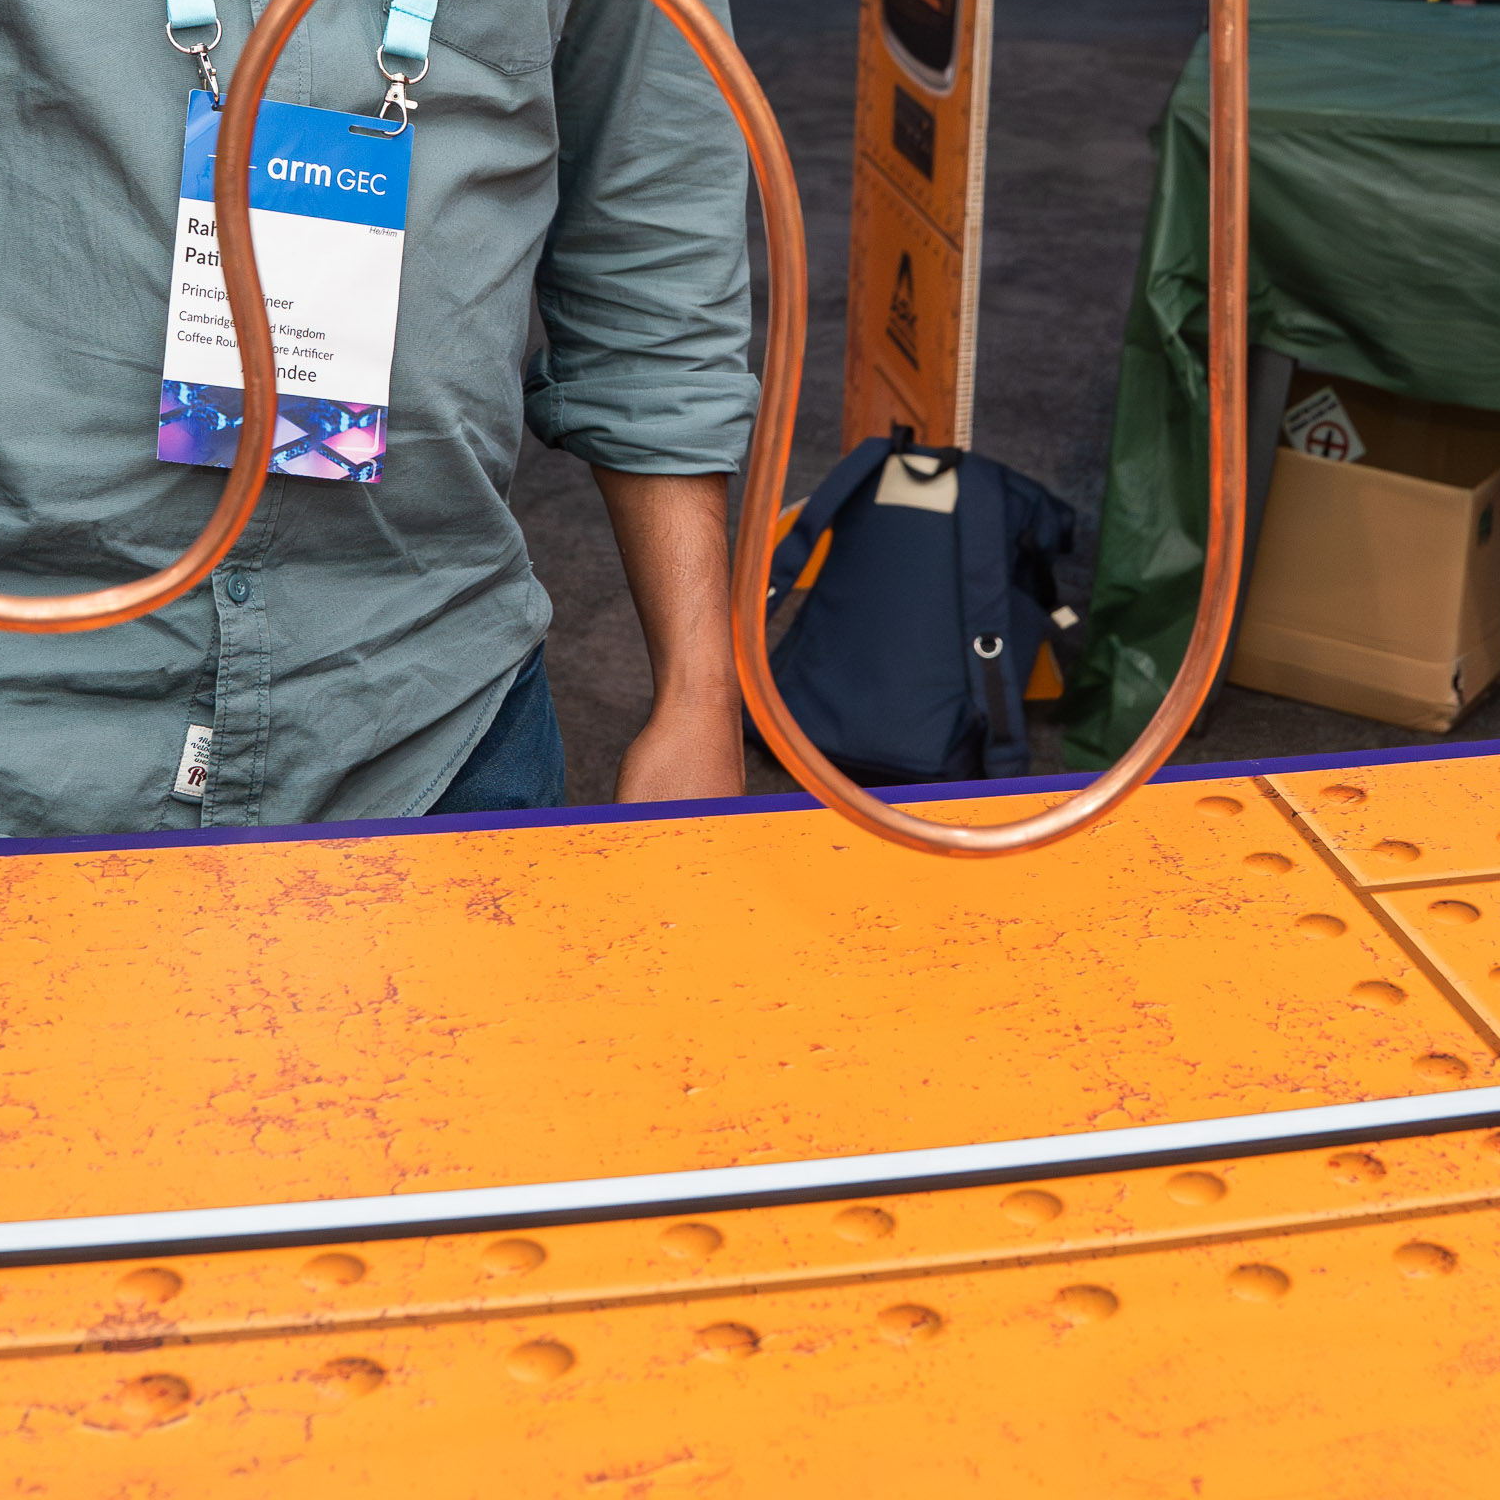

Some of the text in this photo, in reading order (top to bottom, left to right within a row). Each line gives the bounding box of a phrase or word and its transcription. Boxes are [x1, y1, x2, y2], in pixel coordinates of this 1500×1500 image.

[267, 157, 387, 196] arm GEC
[369, 226, 398, 238] He/Him
[185, 247, 223, 267] Pati
[182, 283, 294, 310] Principa ineer
[279, 324, 326, 340] Kingdom
[177, 330, 213, 345] Coffee
[292, 346, 335, 361] Artificer
